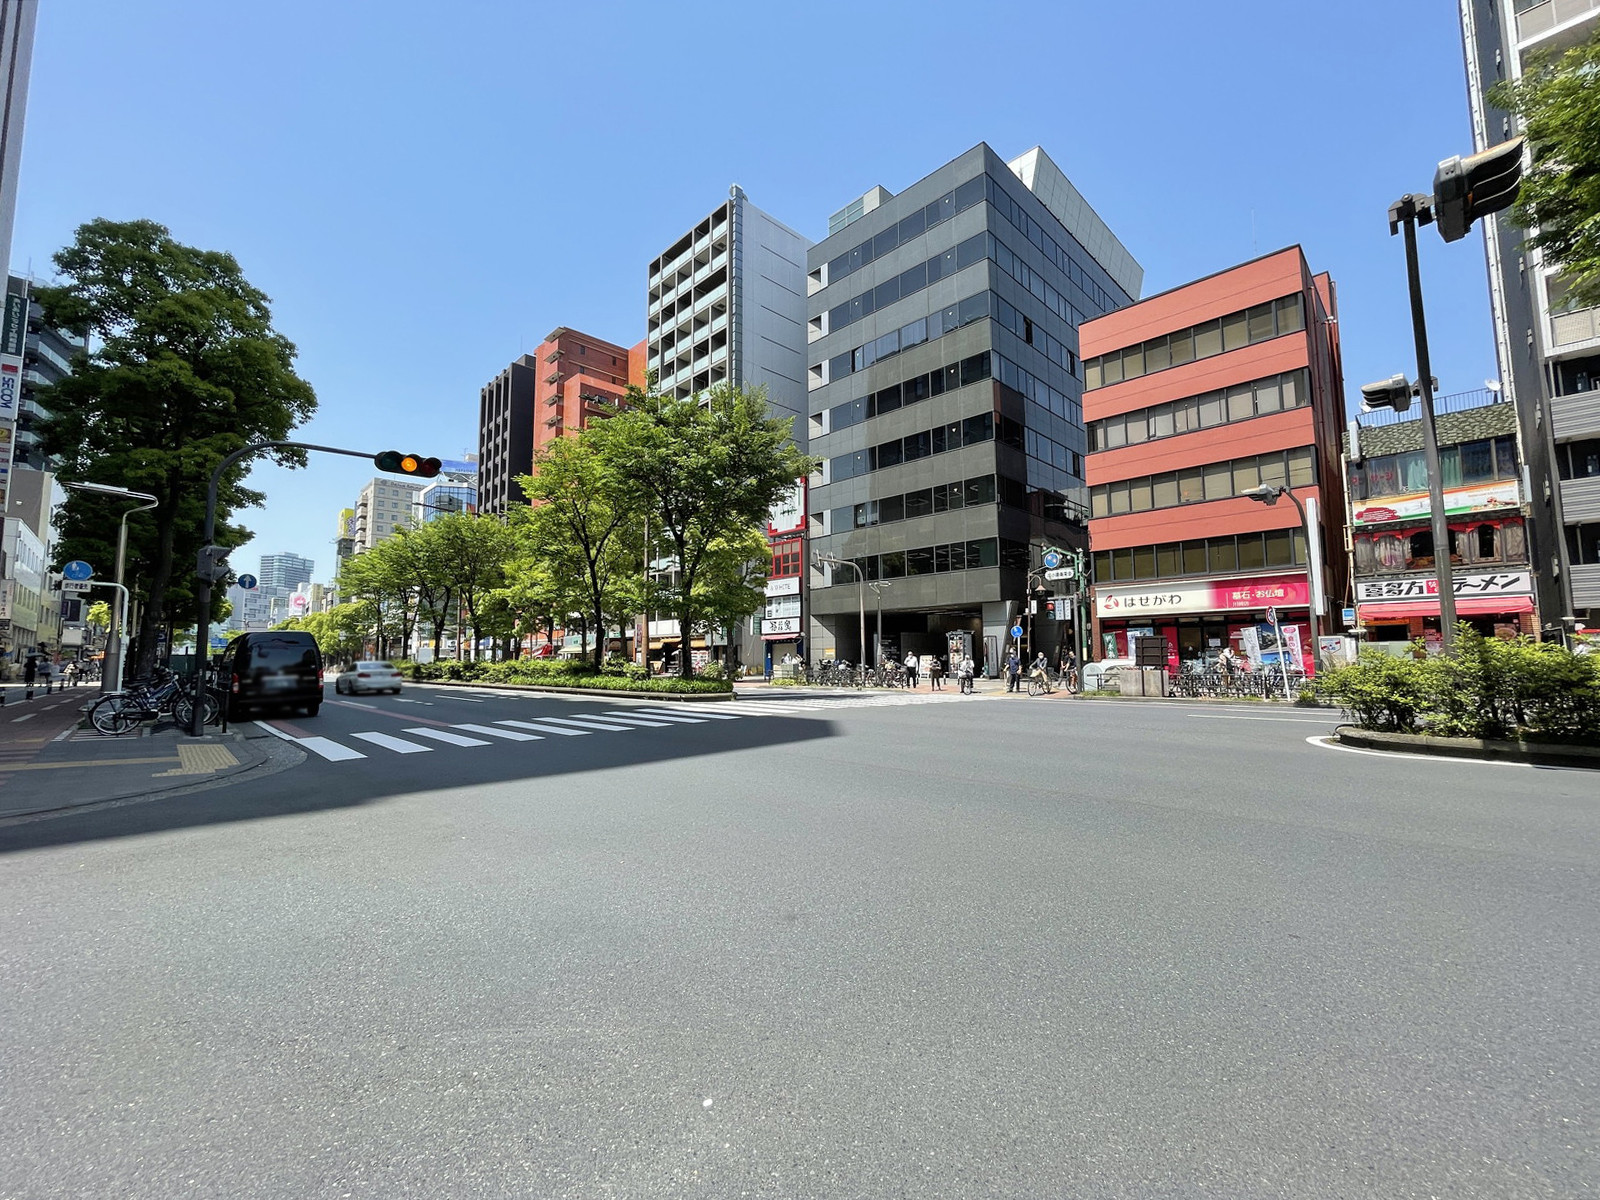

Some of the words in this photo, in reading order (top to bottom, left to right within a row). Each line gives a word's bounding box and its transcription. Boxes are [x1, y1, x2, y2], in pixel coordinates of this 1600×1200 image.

[0, 376, 14, 410] SECOM
[1124, 594, 1182, 608] はせがわ
